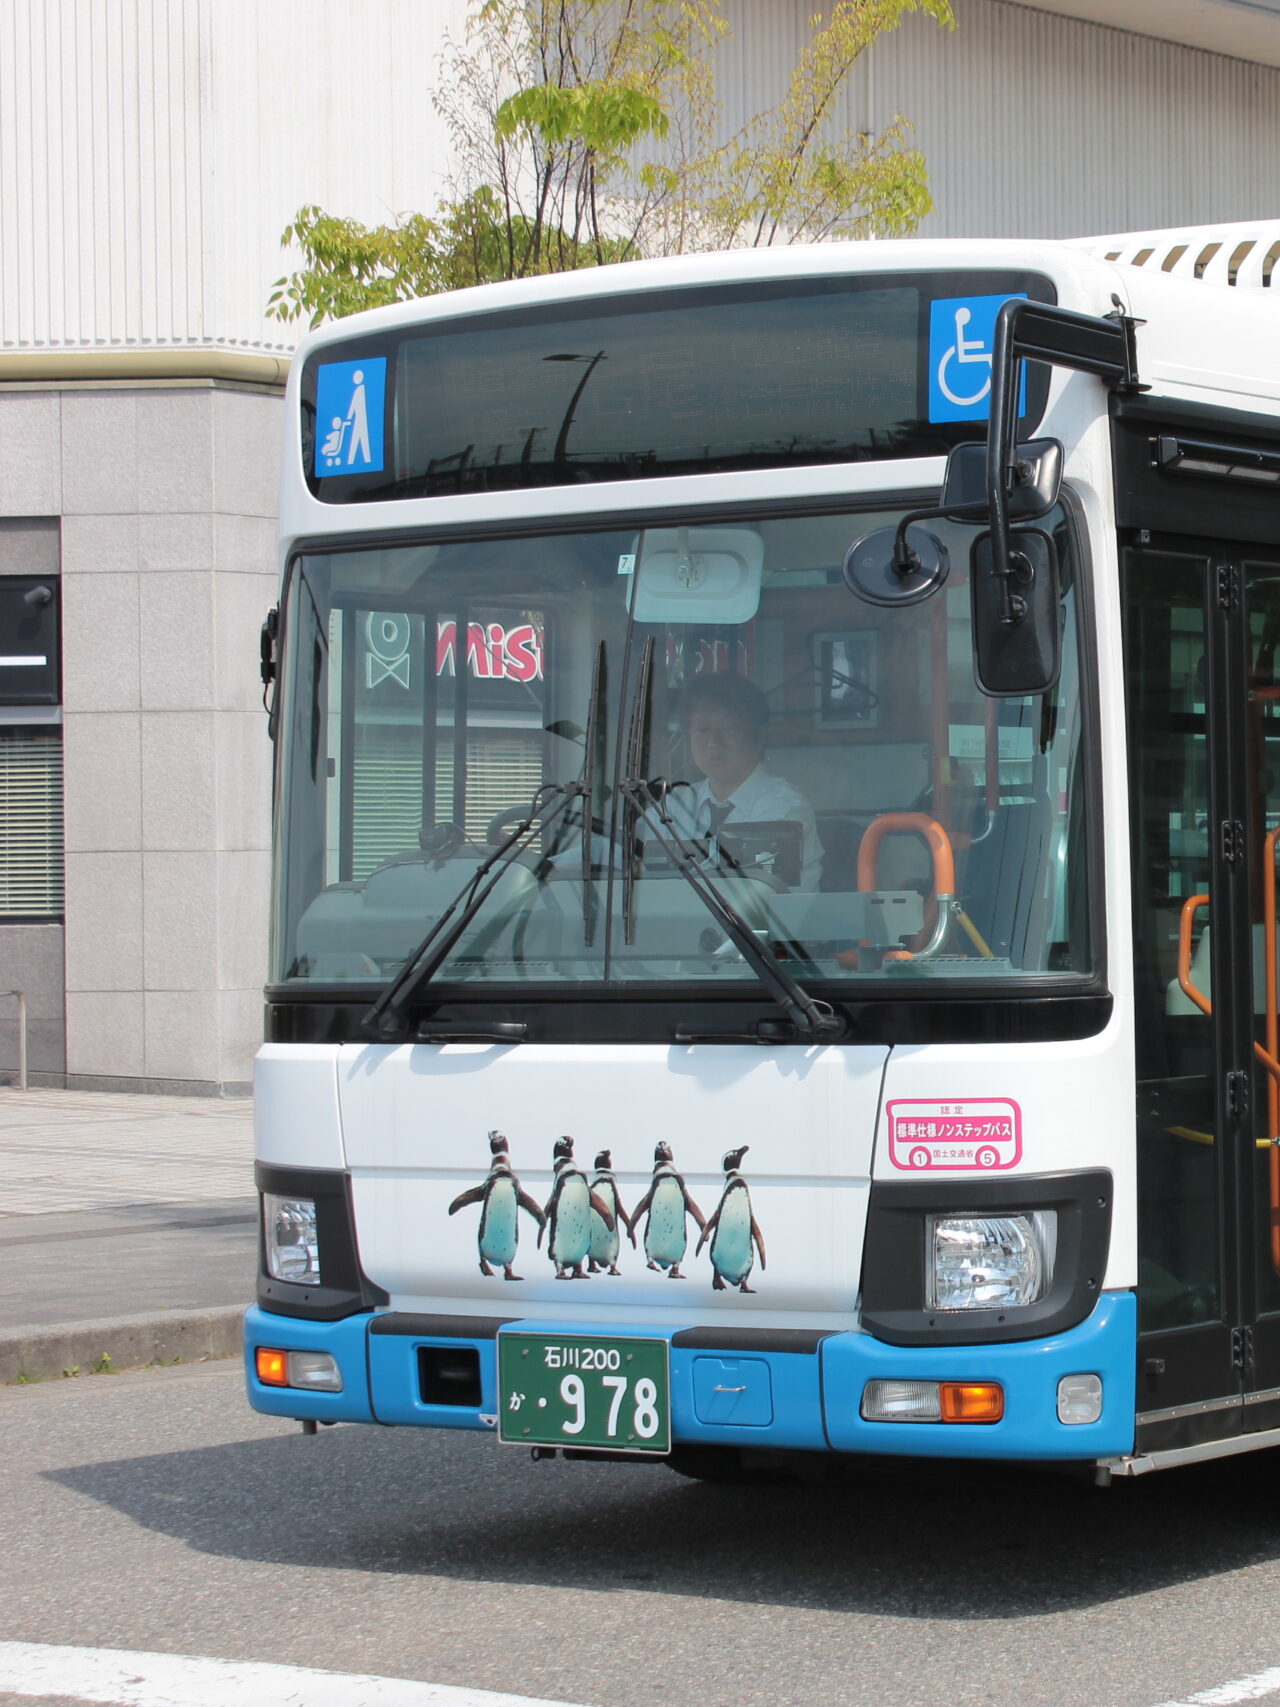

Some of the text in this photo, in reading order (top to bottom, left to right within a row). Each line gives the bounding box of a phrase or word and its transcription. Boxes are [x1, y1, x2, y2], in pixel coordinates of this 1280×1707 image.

[940, 1105, 964, 1115] 認定
[897, 1121, 1012, 1139] 標準仕様ノンステップバス
[933, 1149, 974, 1159] 国土交通省
[984, 1153, 992, 1164] 5
[509, 1392, 526, 1411] か
